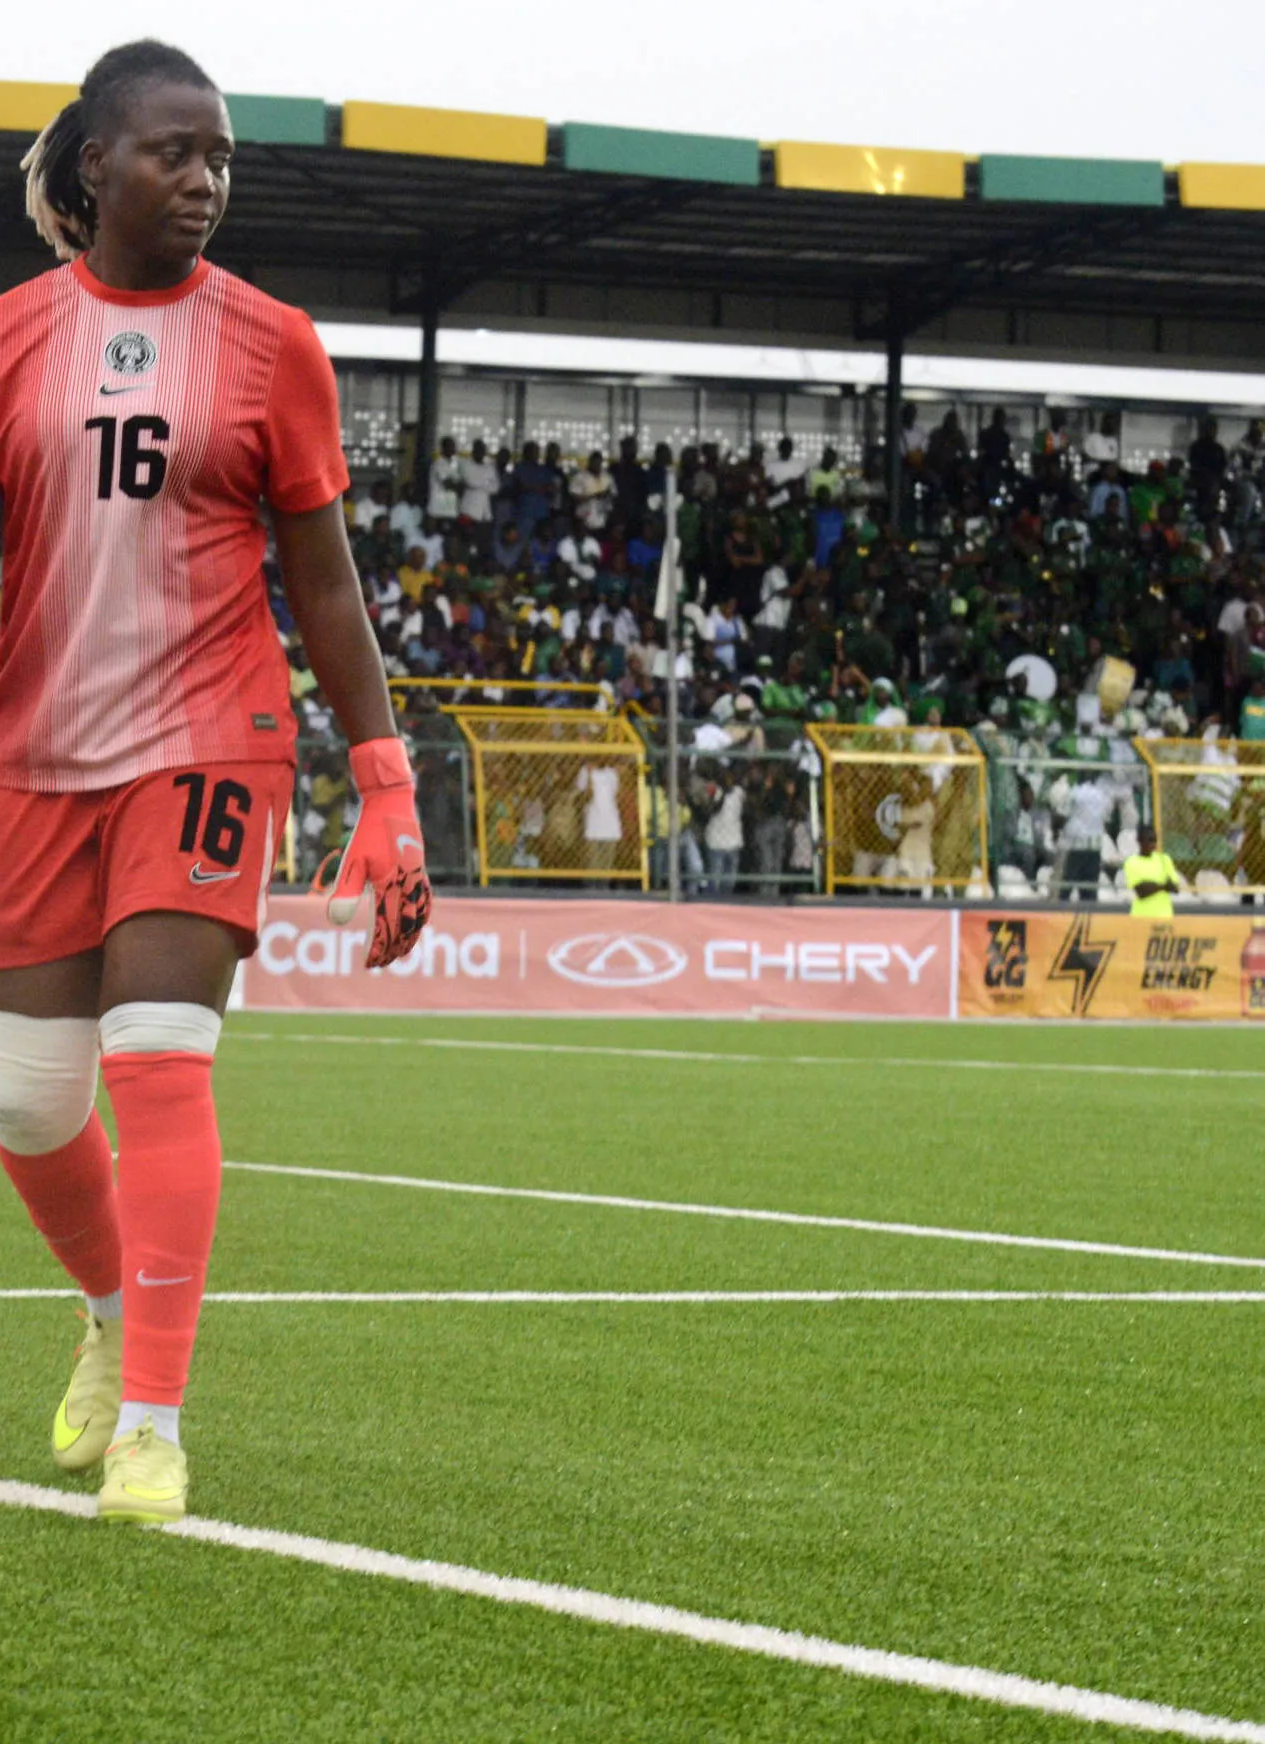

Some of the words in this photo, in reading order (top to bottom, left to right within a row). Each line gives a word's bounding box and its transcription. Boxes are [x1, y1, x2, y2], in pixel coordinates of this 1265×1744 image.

[85, 415, 169, 500] 16
[173, 772, 252, 868] 16
[704, 939, 938, 984] CHERY
